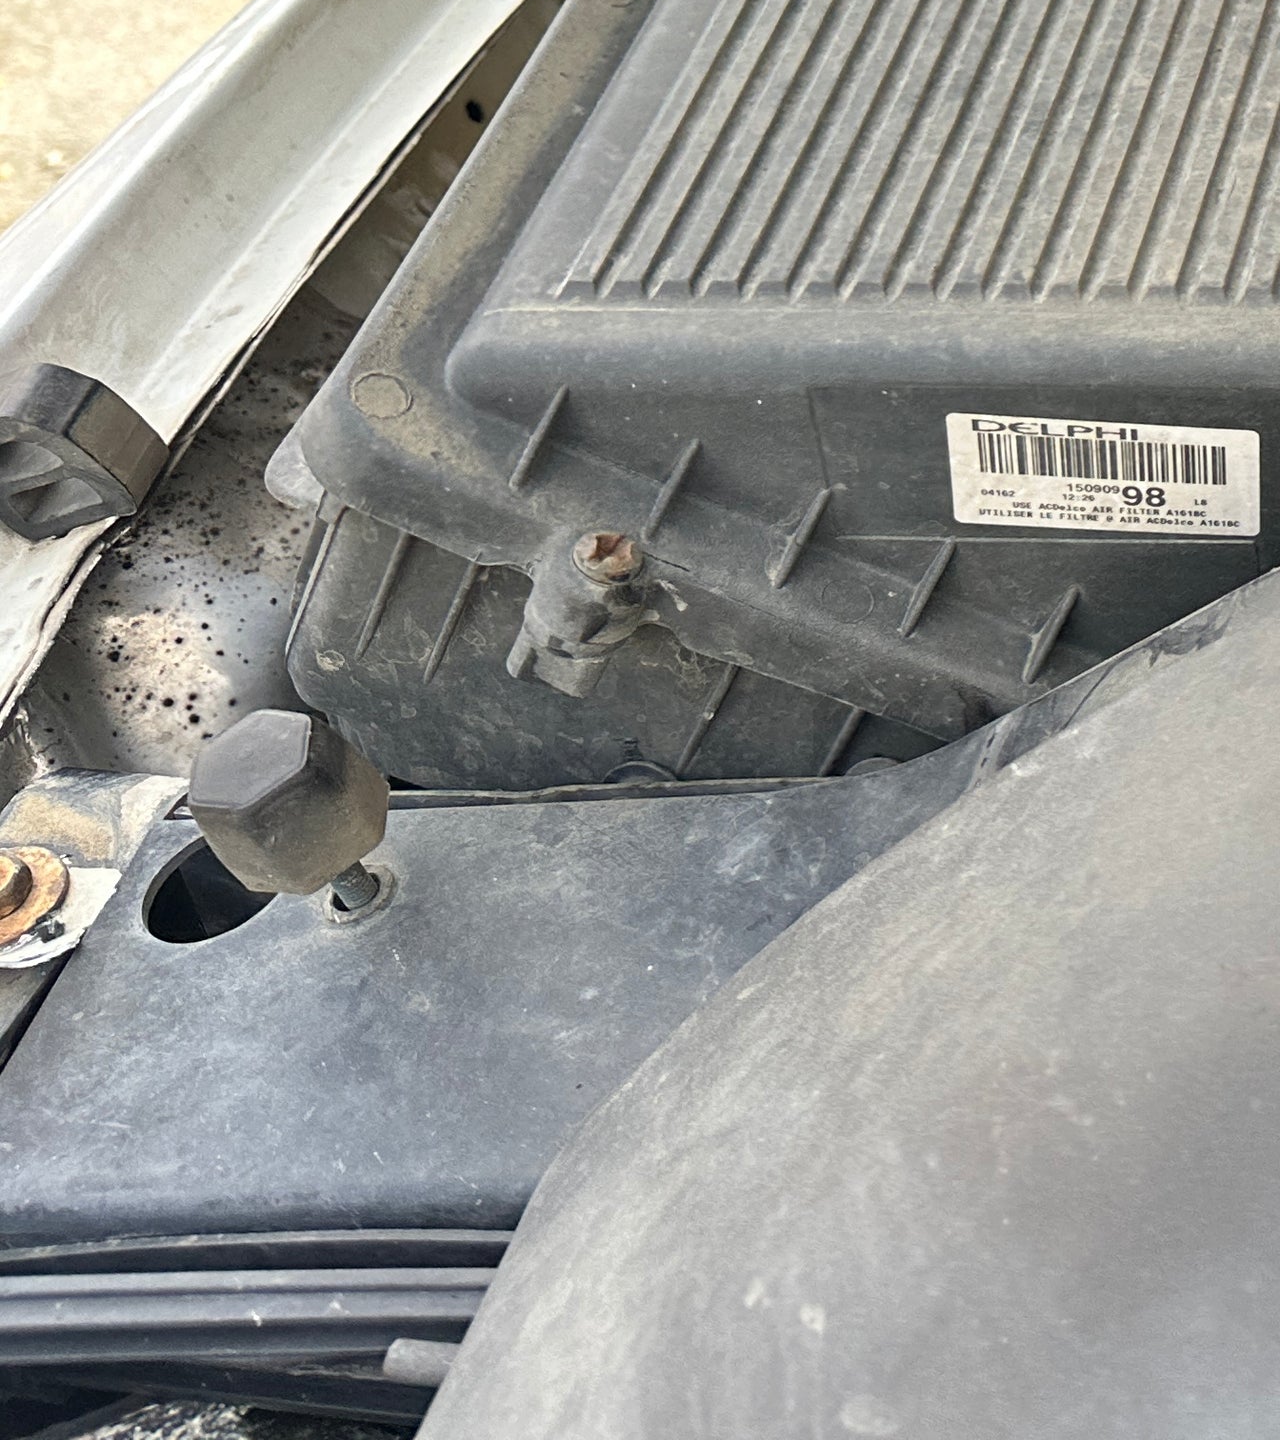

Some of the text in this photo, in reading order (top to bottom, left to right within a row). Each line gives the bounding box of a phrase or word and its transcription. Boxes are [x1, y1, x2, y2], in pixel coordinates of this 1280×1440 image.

[971, 418, 1138, 441] DELPHI
[981, 489, 1016, 498] 04162
[1012, 501, 1035, 510] USE
[1039, 503, 1087, 513] ACDelco
[1092, 506, 1114, 514] AIR
[1119, 507, 1161, 516] FILTER
[978, 508, 1034, 519] UTILISER
[1040, 512, 1053, 520] LE
[1060, 513, 1099, 522] FILTRE
[1119, 516, 1141, 524] AIR
[1146, 517, 1194, 526] ACDelco
